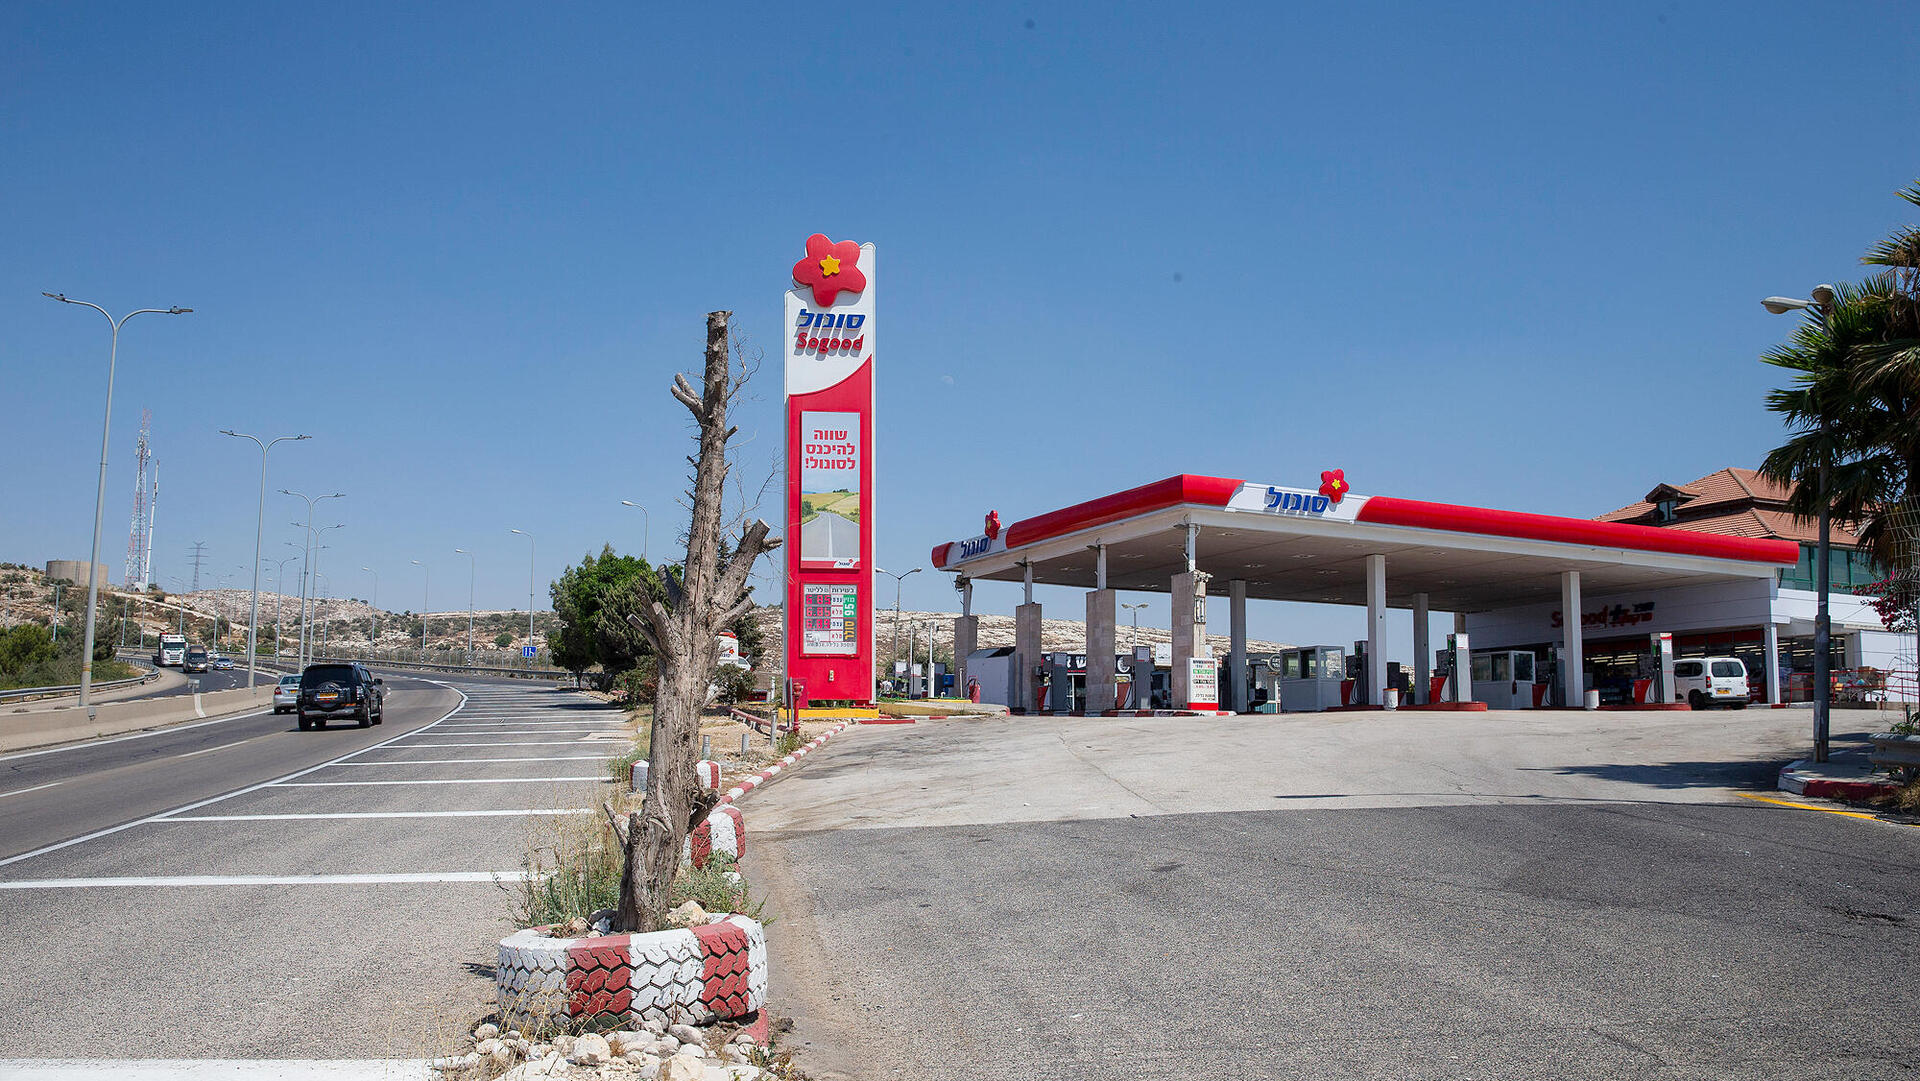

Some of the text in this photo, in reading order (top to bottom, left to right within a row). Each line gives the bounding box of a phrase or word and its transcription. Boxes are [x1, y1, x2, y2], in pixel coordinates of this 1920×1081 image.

[799, 309, 866, 328] סונול
[797, 332, 865, 354] Sogood
[813, 430, 848, 440] שווה
[805, 442, 855, 455] להיכנס
[805, 456, 856, 470] לסונול!
[1267, 486, 1330, 513] סונול
[960, 537, 989, 559] סונול
[1551, 605, 1608, 628] Sood
